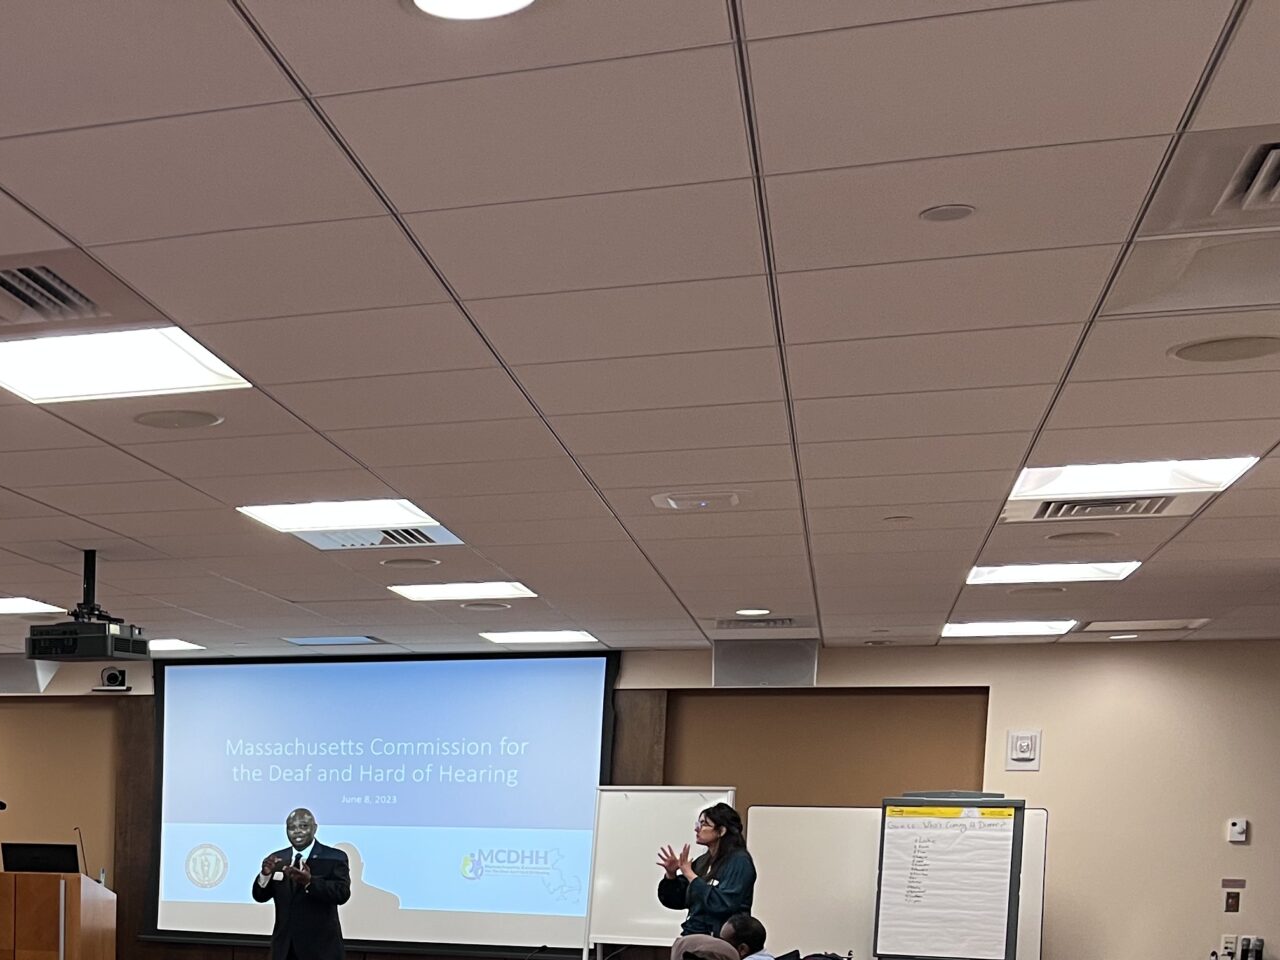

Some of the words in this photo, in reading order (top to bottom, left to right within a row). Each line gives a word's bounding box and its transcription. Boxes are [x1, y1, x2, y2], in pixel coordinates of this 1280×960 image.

[225, 737, 365, 756] Massachusetts
[369, 737, 492, 756] Commission
[499, 736, 529, 756] for
[232, 763, 262, 782] the
[269, 763, 313, 782] Deaf
[317, 763, 352, 782] and
[359, 763, 405, 782] Hard
[412, 763, 433, 782] of
[439, 764, 518, 787] Hearing
[341, 795, 362, 804] June
[375, 795, 397, 804] 2023
[478, 848, 548, 865] MCDHH
